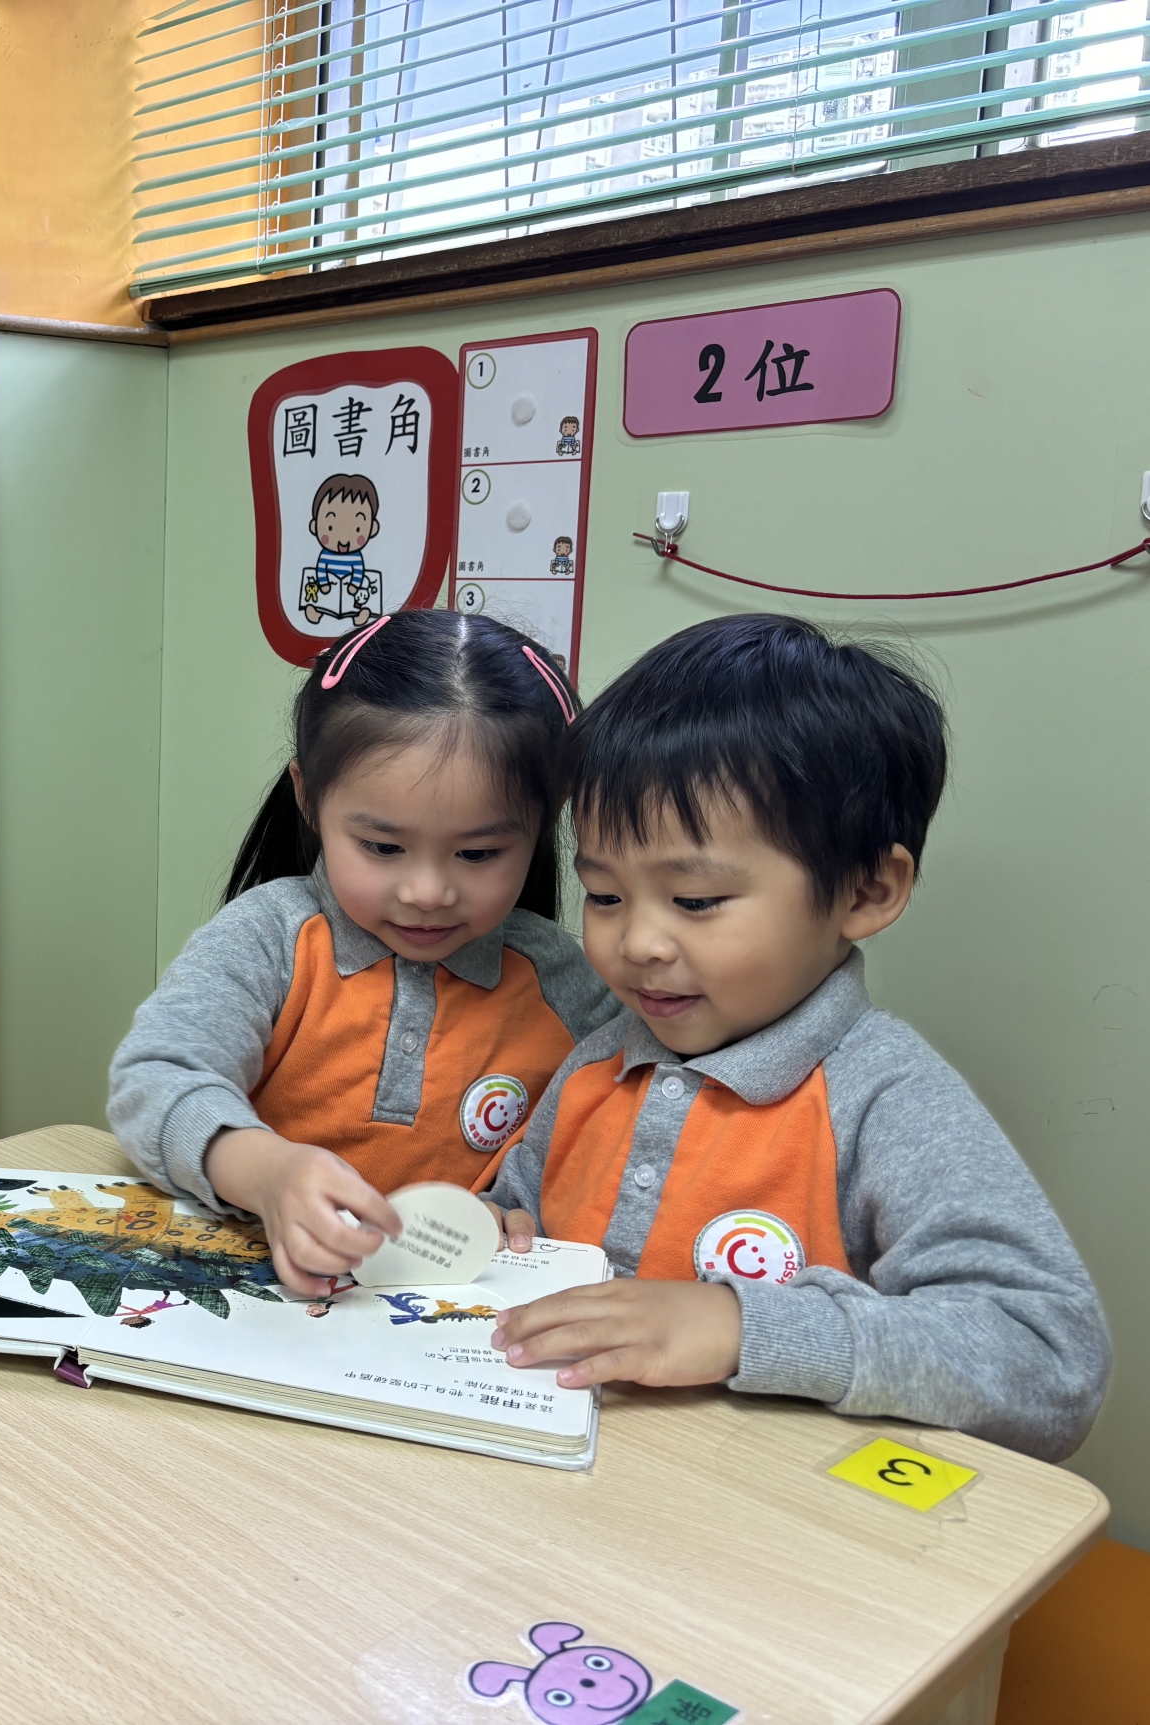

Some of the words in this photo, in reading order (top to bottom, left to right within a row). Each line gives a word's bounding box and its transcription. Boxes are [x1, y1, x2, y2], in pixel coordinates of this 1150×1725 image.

[694, 344, 726, 404] 2
[744, 339, 815, 402] 位
[282, 393, 420, 459] 圖書角
[463, 446, 490, 458] 圖書角
[471, 477, 481, 493] 2
[458, 561, 484, 572] 圖書角
[466, 591, 476, 607] 3
[775, 1251, 797, 1285] kspc
[425, 1352, 509, 1364] 還有個巨大的
[876, 1457, 932, 1487] 3
